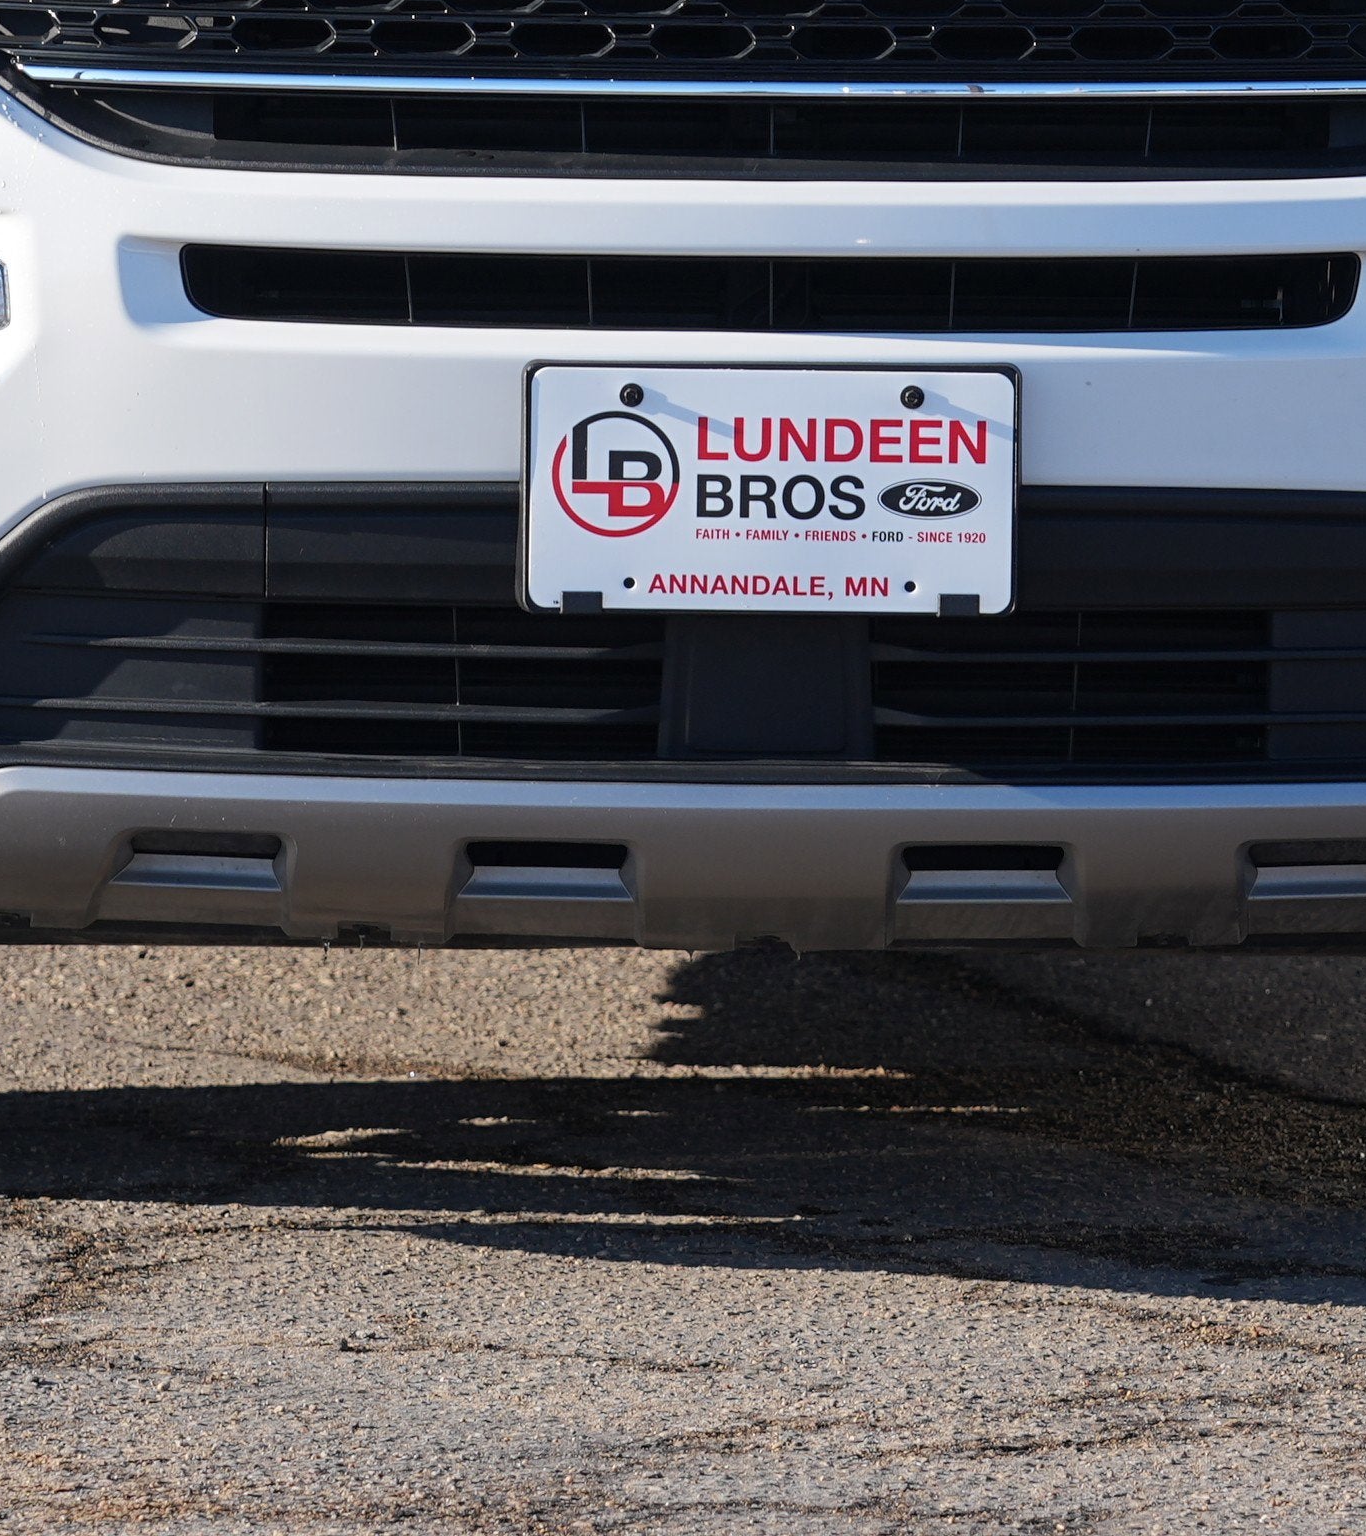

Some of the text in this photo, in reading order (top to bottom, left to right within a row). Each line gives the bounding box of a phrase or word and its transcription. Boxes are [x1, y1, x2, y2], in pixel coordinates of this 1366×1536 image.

[697, 416, 988, 465] LUNDEEN
[696, 473, 866, 521] BROS
[898, 483, 962, 512] Ford
[695, 528, 987, 544] FAITH FAMILY FRIENDS FORD SINCE 1920
[648, 573, 890, 600] ANNANDALE, MN
